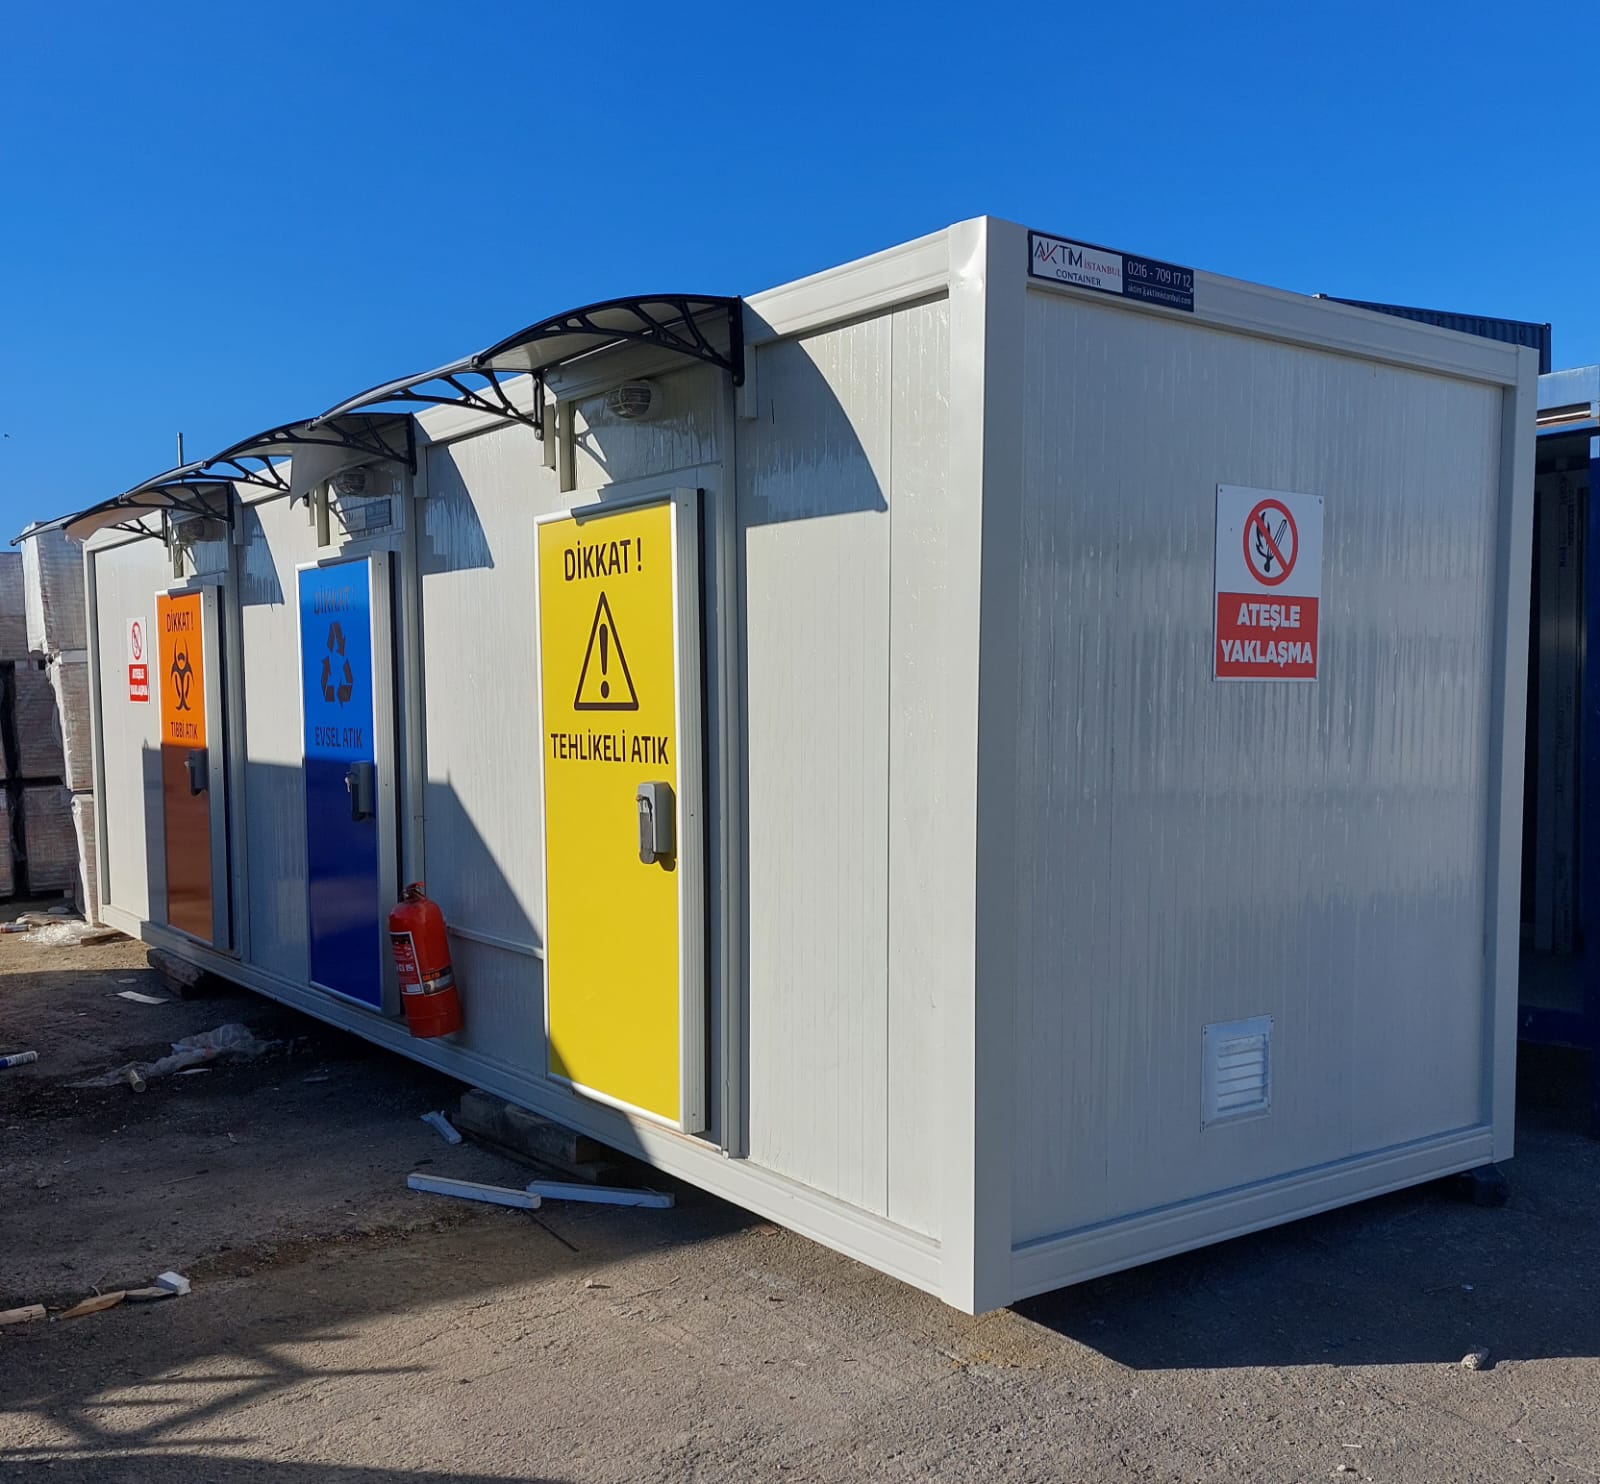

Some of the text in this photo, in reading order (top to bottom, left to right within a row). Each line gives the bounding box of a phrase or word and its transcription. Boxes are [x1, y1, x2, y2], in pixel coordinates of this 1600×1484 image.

[1056, 269, 1102, 287] CONTAINER
[1127, 261, 1148, 278] 0216
[1155, 267, 1171, 284] 709
[1173, 272, 1181, 285] 17
[1182, 275, 1192, 288] 12
[563, 539, 631, 581] DİKKAT
[313, 585, 350, 615] DİKKAT
[166, 609, 190, 632] DİKKAT
[1236, 602, 1301, 632] ATEŞLE
[1220, 639, 1313, 668] YAKLAŞMA
[185, 723, 198, 739] ATIK
[315, 726, 362, 749] EVSEL ATIK
[550, 729, 669, 765] TEHLİKELİ ATIK
